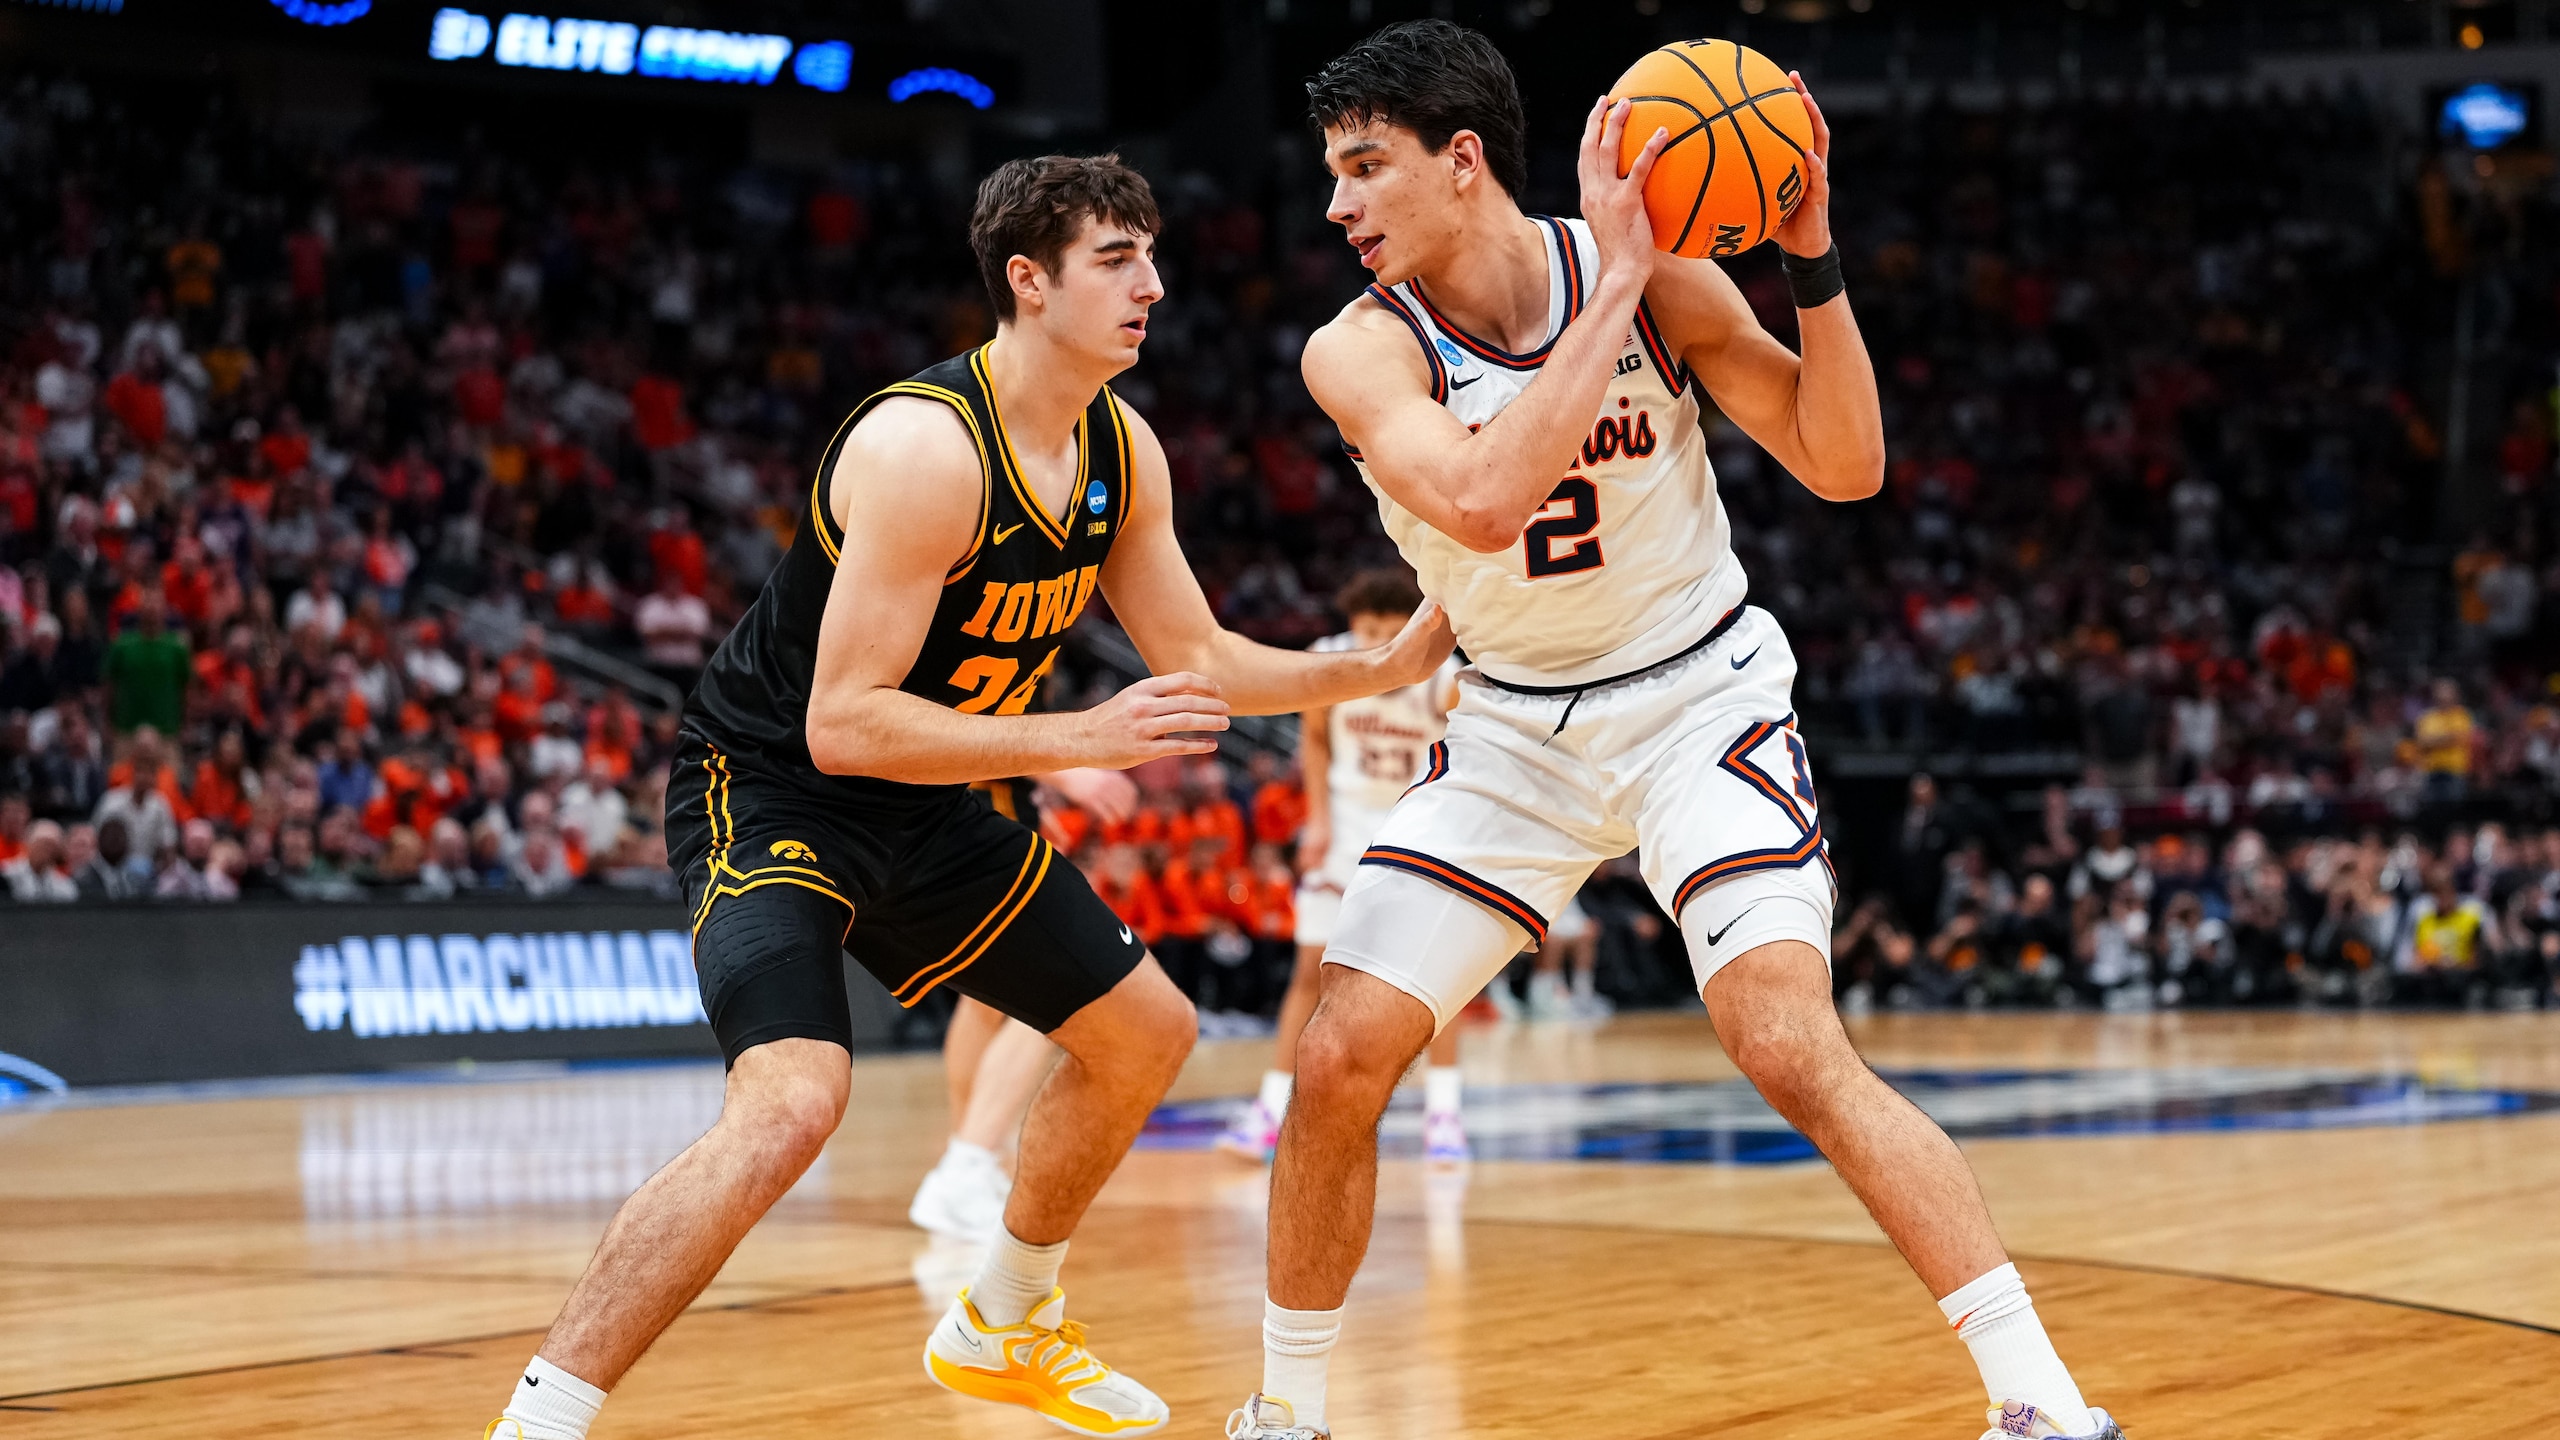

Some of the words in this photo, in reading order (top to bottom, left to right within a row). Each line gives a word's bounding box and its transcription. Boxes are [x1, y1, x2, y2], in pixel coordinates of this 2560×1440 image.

[495, 12, 639, 75] ELITE
[1523, 475, 1605, 579] 2
[292, 929, 710, 1039] #MARCHMAD
[2001, 1420, 2026, 1436] BOOK
